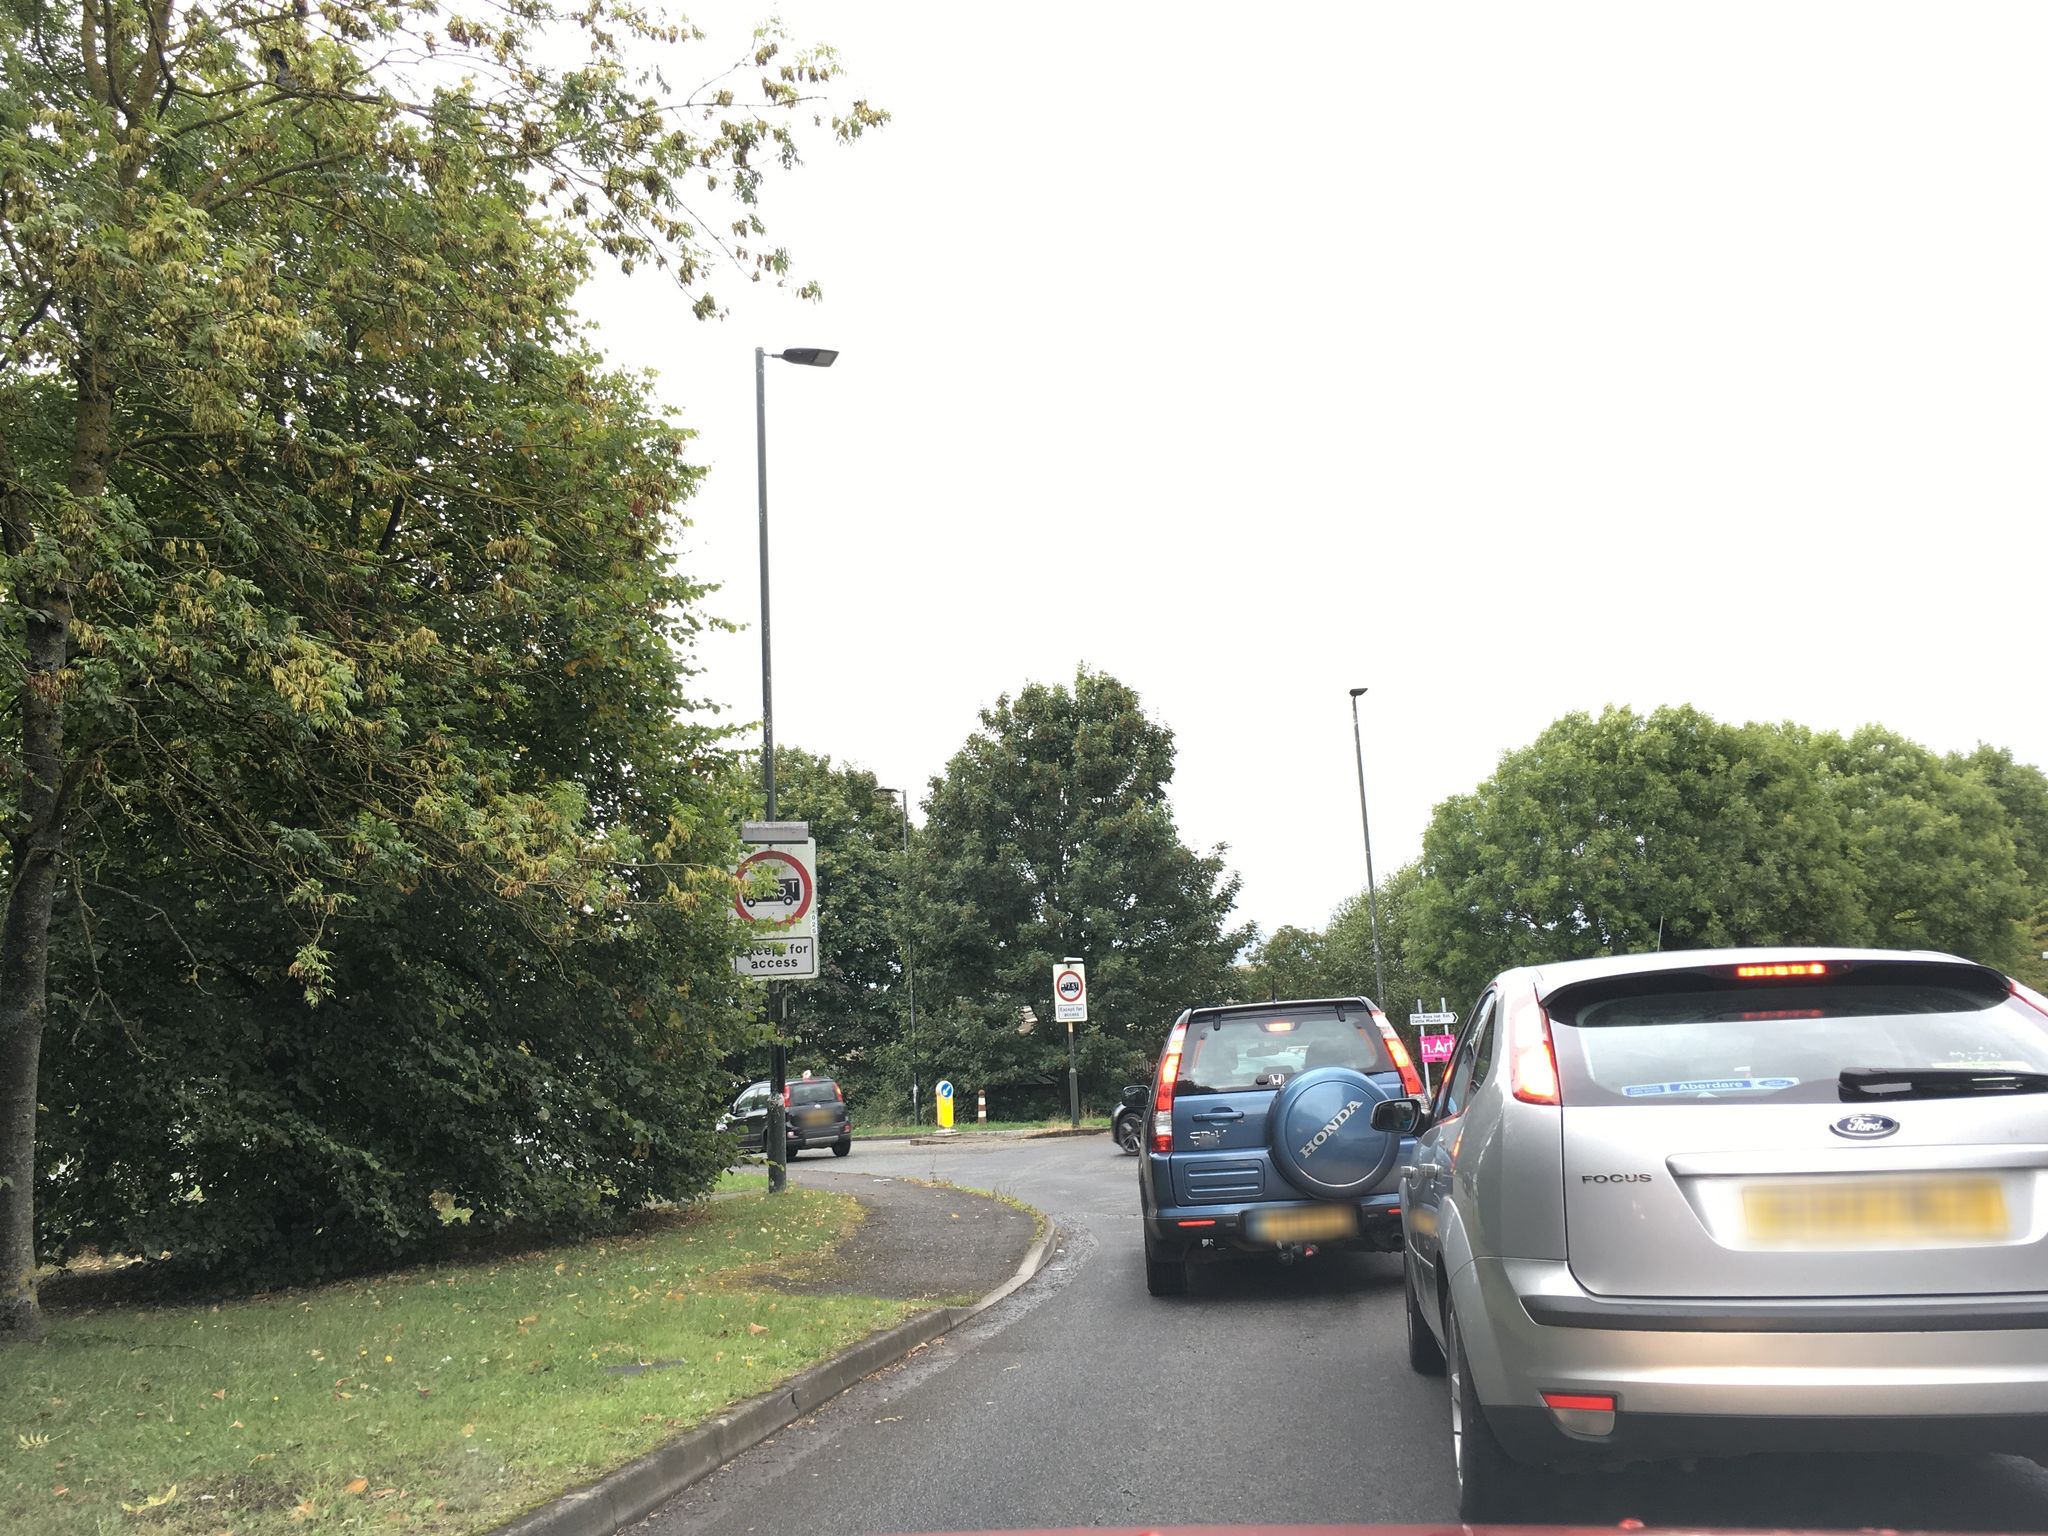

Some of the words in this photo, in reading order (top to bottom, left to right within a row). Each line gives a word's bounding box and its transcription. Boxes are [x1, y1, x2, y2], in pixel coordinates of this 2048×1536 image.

[790, 943, 808, 954] for
[751, 958, 798, 969] access
[1678, 1080, 1744, 1091] Aberdare
[1298, 1100, 1364, 1159] HONDA
[1847, 1116, 1884, 1133] Ford
[1581, 1173, 1652, 1185] FOCUS
